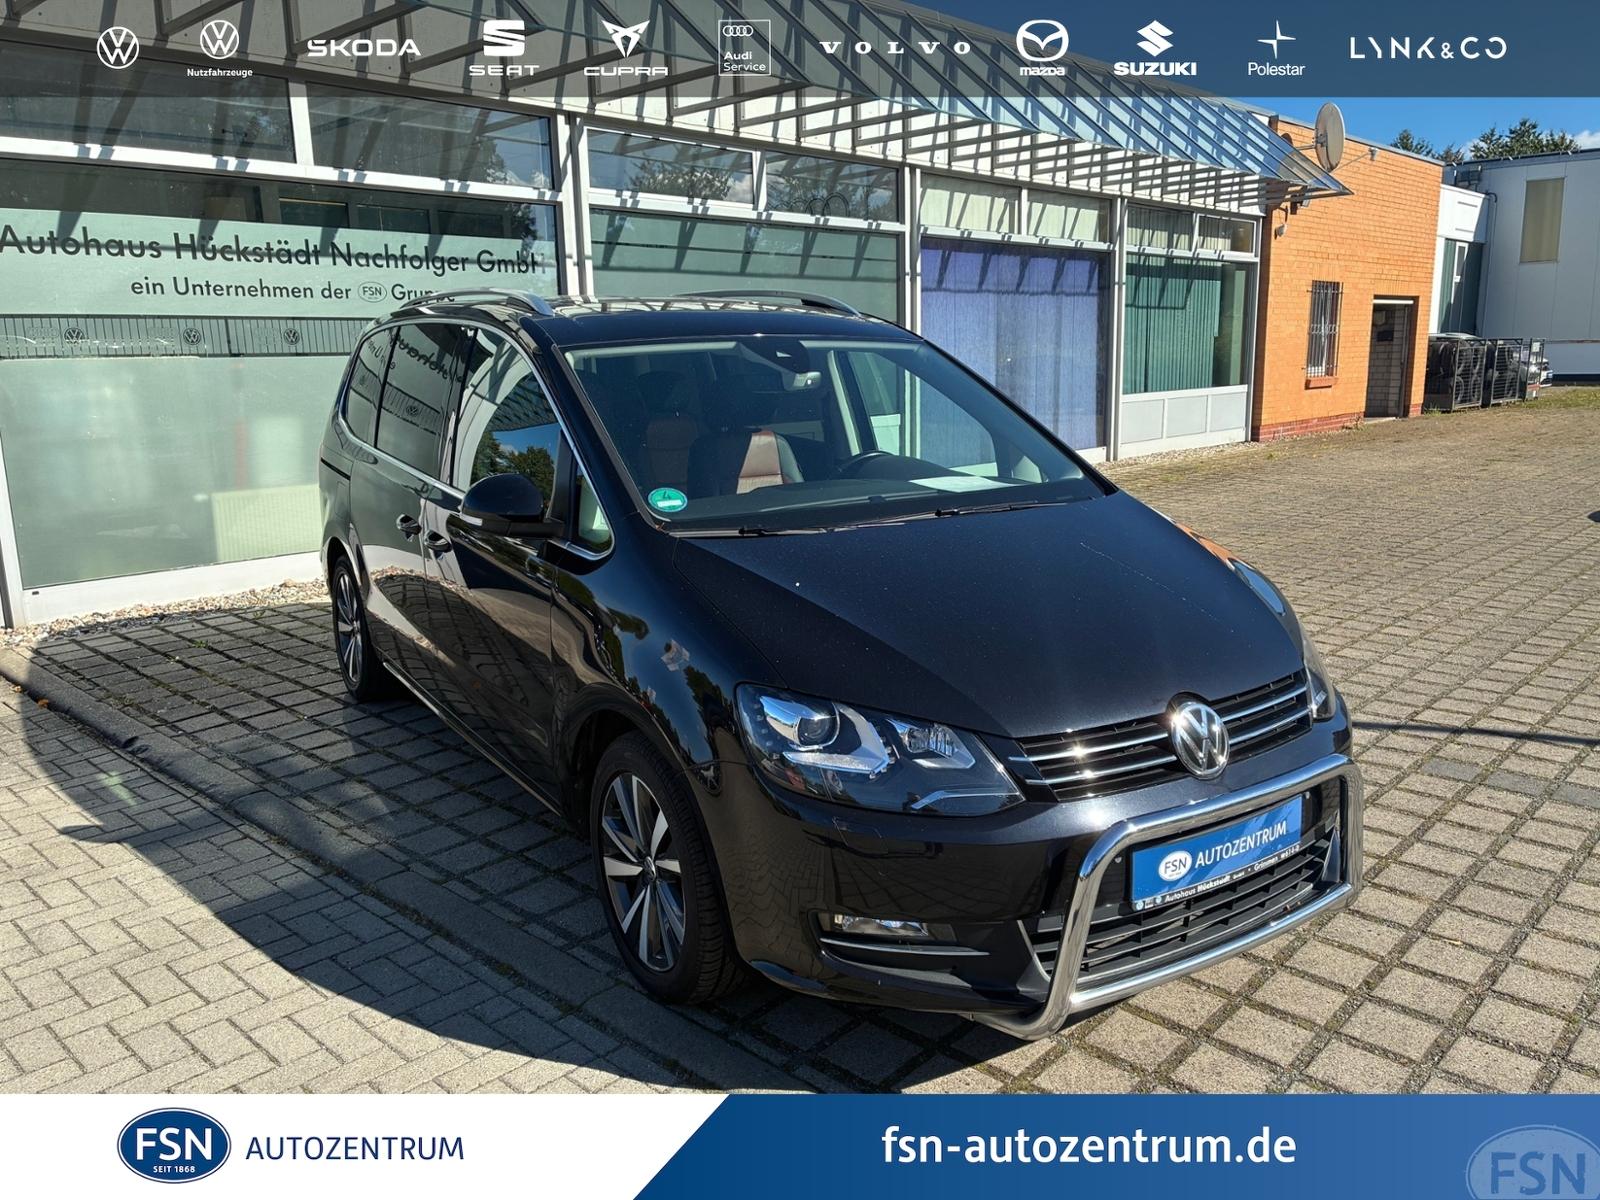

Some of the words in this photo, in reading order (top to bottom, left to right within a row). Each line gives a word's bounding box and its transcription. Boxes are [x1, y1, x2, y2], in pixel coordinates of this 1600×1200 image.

[0, 224, 162, 259] Autohaus
[173, 232, 320, 265] Hückstädt
[330, 241, 470, 277] Nachfolger
[131, 276, 165, 295] ein
[173, 276, 314, 299] Unternehmen
[321, 280, 352, 299] der
[362, 286, 382, 296] FSN
[1163, 857, 1188, 875] FSN
[1195, 820, 1287, 869] AUTOZENTRUM
[1164, 888, 1197, 903] Autohaus
